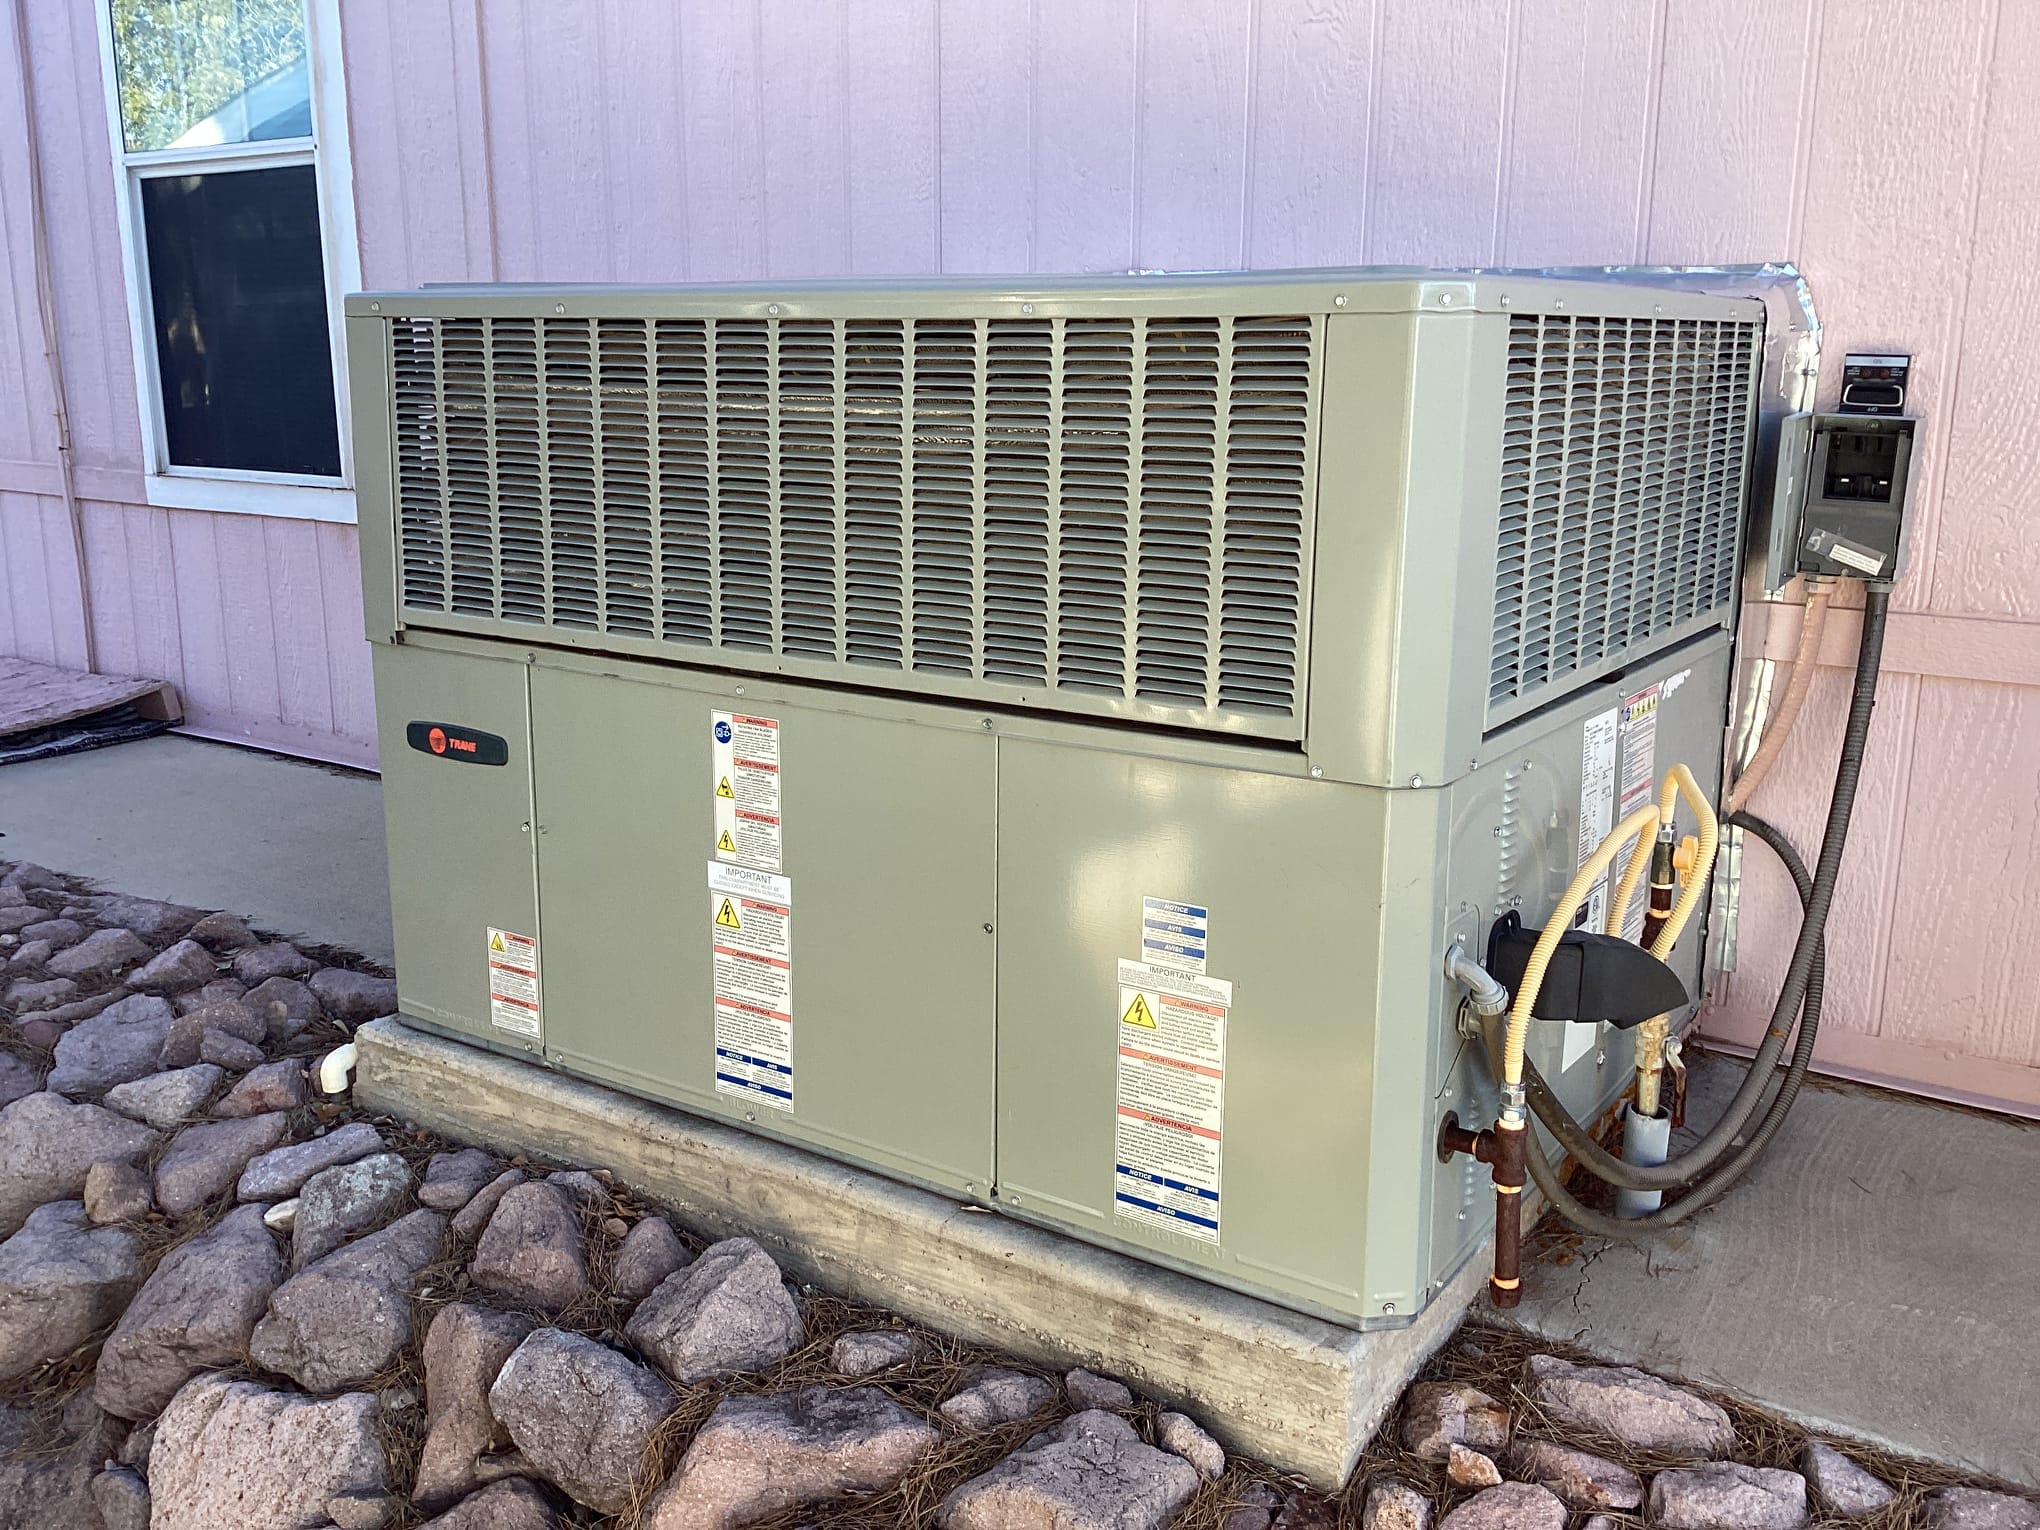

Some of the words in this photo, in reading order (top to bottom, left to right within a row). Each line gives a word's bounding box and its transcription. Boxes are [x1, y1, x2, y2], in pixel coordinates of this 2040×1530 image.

[449, 738, 477, 753] TRANE
[726, 867, 772, 884] IMPORTANT
[1164, 903, 1189, 913] NOTICE
[1164, 944, 1185, 953] AVISO
[1149, 965, 1197, 981] IMPORTANT
[1180, 1001, 1209, 1012] WARNING
[725, 1051, 744, 1061] NOTICE
[1149, 1055, 1197, 1072] AVERTISSEMENT
[747, 1082, 762, 1090] AVISO
[1150, 1116, 1192, 1131] ADVERTENCIA
[1128, 1169, 1153, 1181] NOTICE
[1183, 1185, 1199, 1194] AVIS
[1156, 1206, 1177, 1217] AVISO
